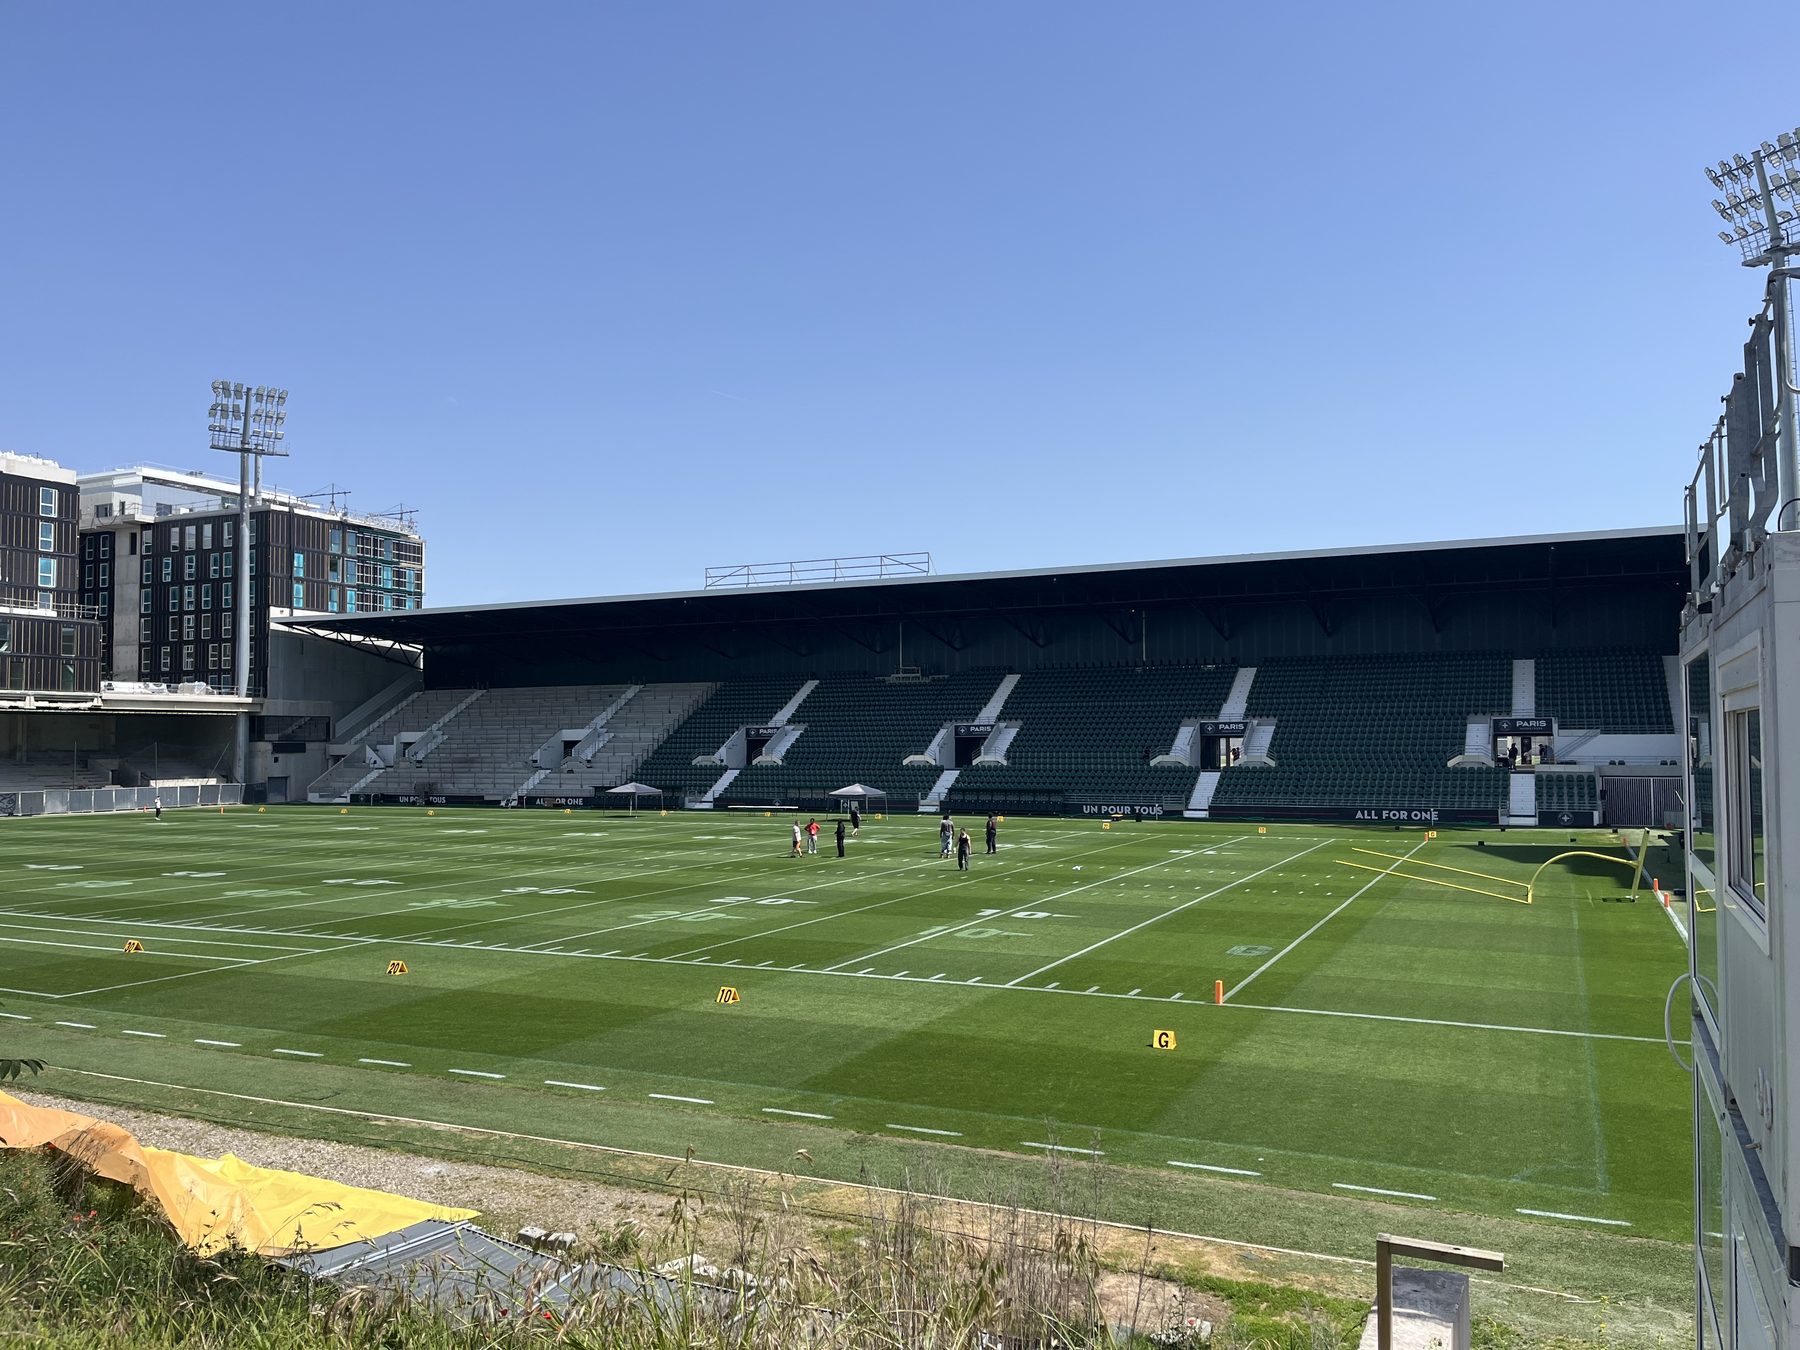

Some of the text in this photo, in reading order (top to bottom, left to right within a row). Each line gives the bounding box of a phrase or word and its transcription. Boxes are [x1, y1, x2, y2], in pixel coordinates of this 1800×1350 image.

[567, 798, 583, 806] ONE
[1082, 805, 1163, 815] UN POUR TOUS
[1355, 810, 1439, 820] ALL FOR ONE
[387, 962, 400, 975] 20
[719, 988, 732, 1003] 10
[1158, 1031, 1169, 1048] G
